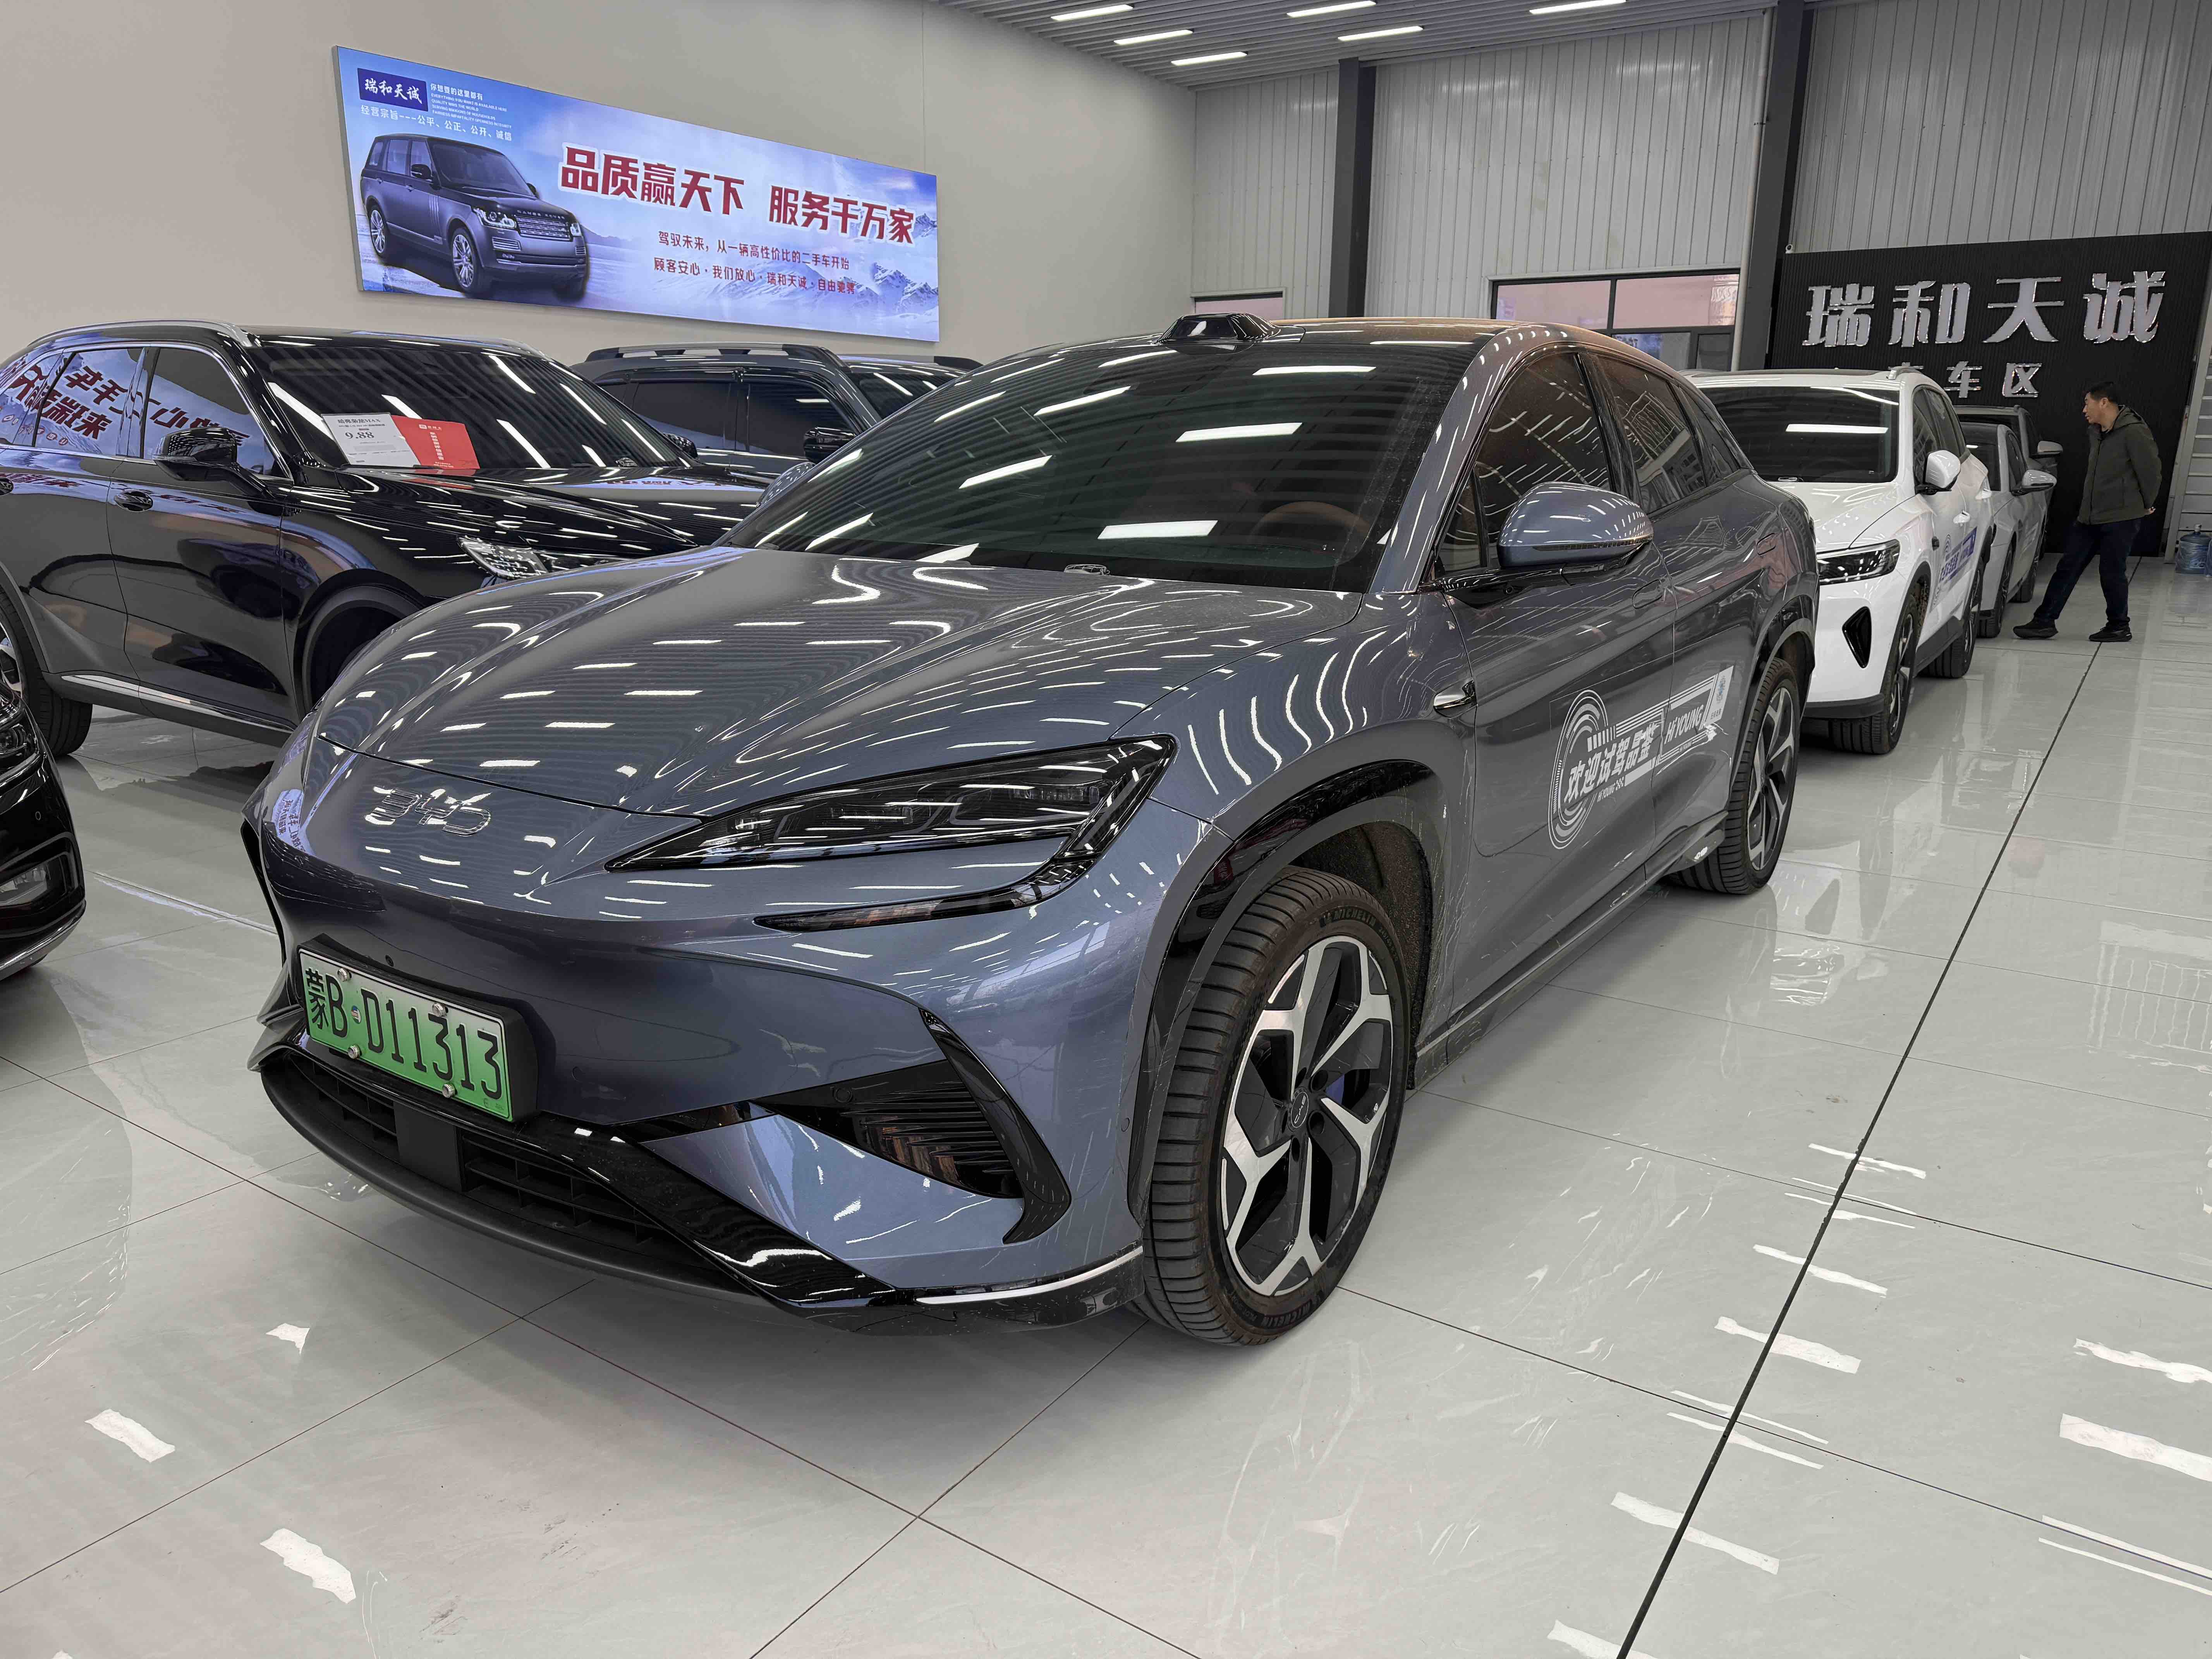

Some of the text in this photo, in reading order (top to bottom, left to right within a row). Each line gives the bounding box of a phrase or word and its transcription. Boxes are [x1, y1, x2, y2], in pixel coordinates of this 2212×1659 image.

[364, 78, 422, 104] 瑞和天诚
[431, 83, 483, 101] 你想要的这里都有
[561, 146, 915, 246] 品质赢天下 服务千万家
[1802, 270, 2166, 348] 瑞和天诚
[1889, 361, 2043, 398] 车区
[1332, 907, 1377, 927] MICHELIN
